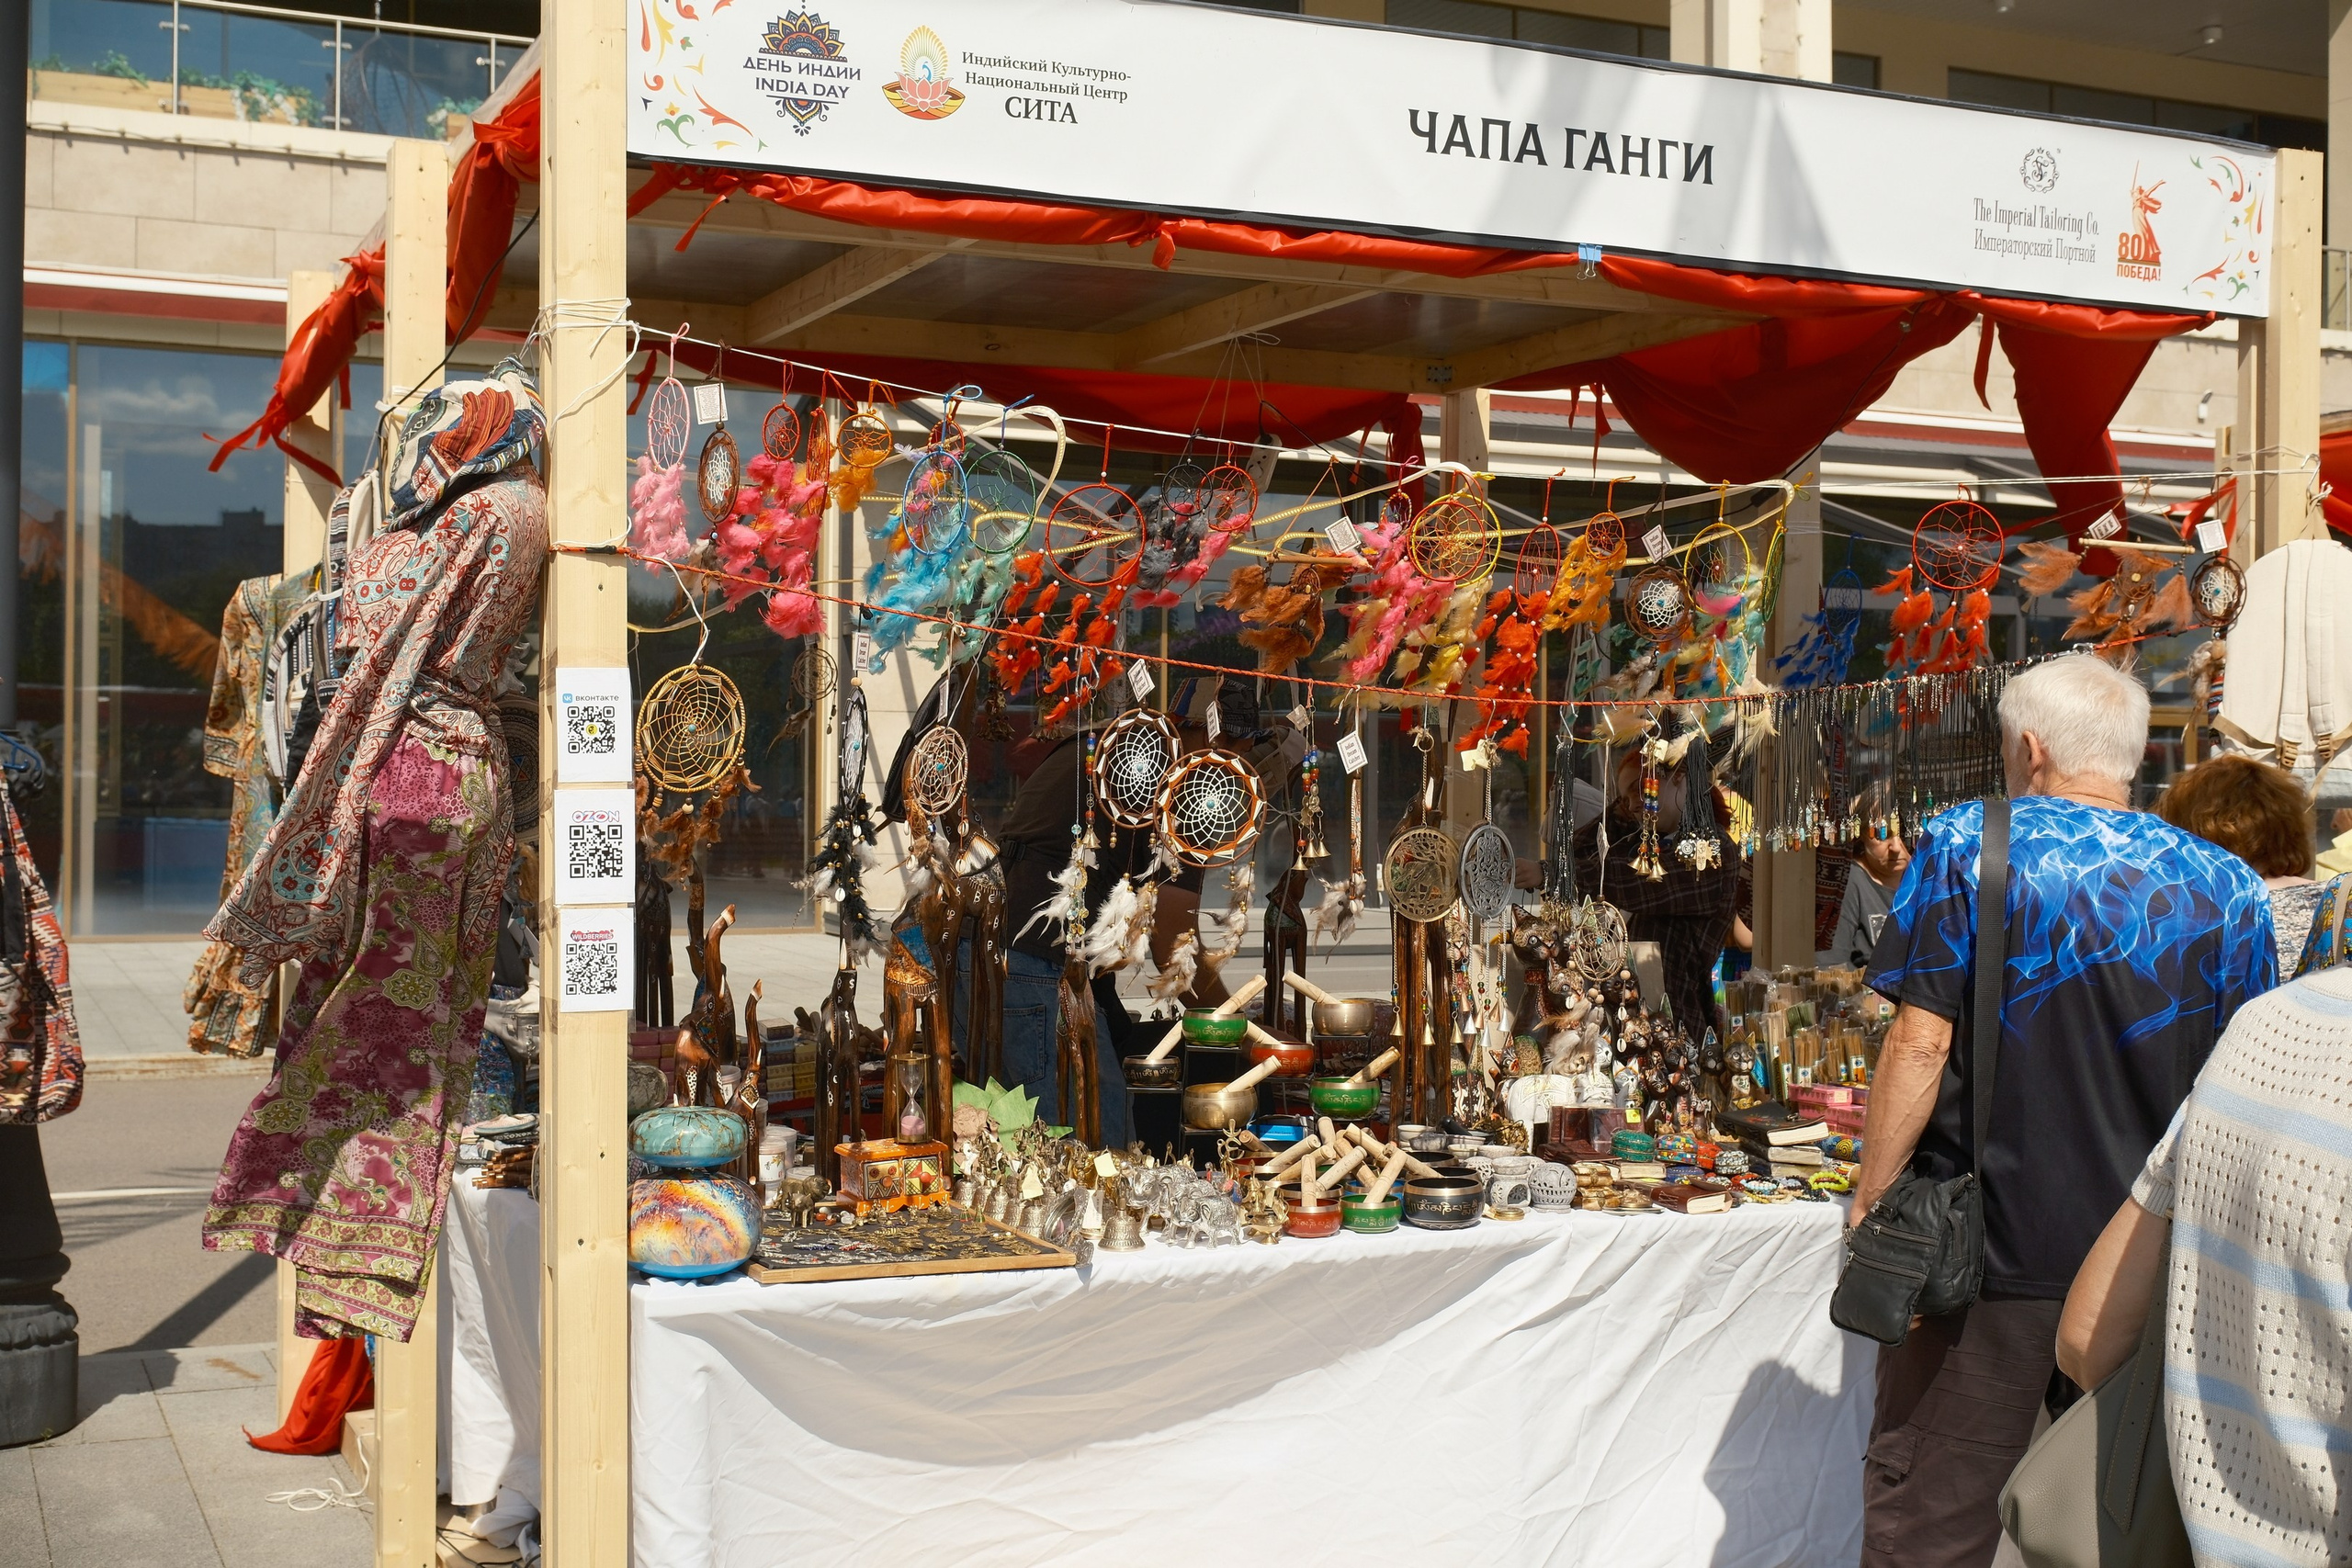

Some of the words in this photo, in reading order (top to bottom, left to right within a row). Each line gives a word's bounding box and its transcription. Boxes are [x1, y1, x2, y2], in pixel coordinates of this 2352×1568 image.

[743, 56, 792, 73] ДЕНЬ
[798, 62, 861, 81] ИНДИИ
[962, 51, 1047, 73] Индийский
[1051, 61, 1132, 82] Культурно-
[755, 77, 808, 96] INDIA
[813, 83, 851, 99] DAY
[965, 72, 1080, 96] Национальный
[1083, 85, 1128, 104] Центр
[1004, 96, 1079, 124] СИТА
[1408, 108, 1549, 166] ЧАПА
[1563, 127, 1715, 186] ГАНГИ
[1973, 197, 1992, 222] The
[1994, 200, 2037, 232] Imperial
[2039, 205, 2084, 241] Tailoring
[2086, 211, 2100, 236] Co.
[1973, 228, 2052, 260] Императорский
[2055, 238, 2097, 265] Портной
[2118, 231, 2145, 261] 80
[2117, 264, 2162, 283] ПОБЕДА!
[571, 809, 620, 824] OZON
[571, 931, 614, 941] WILDBERRIES
